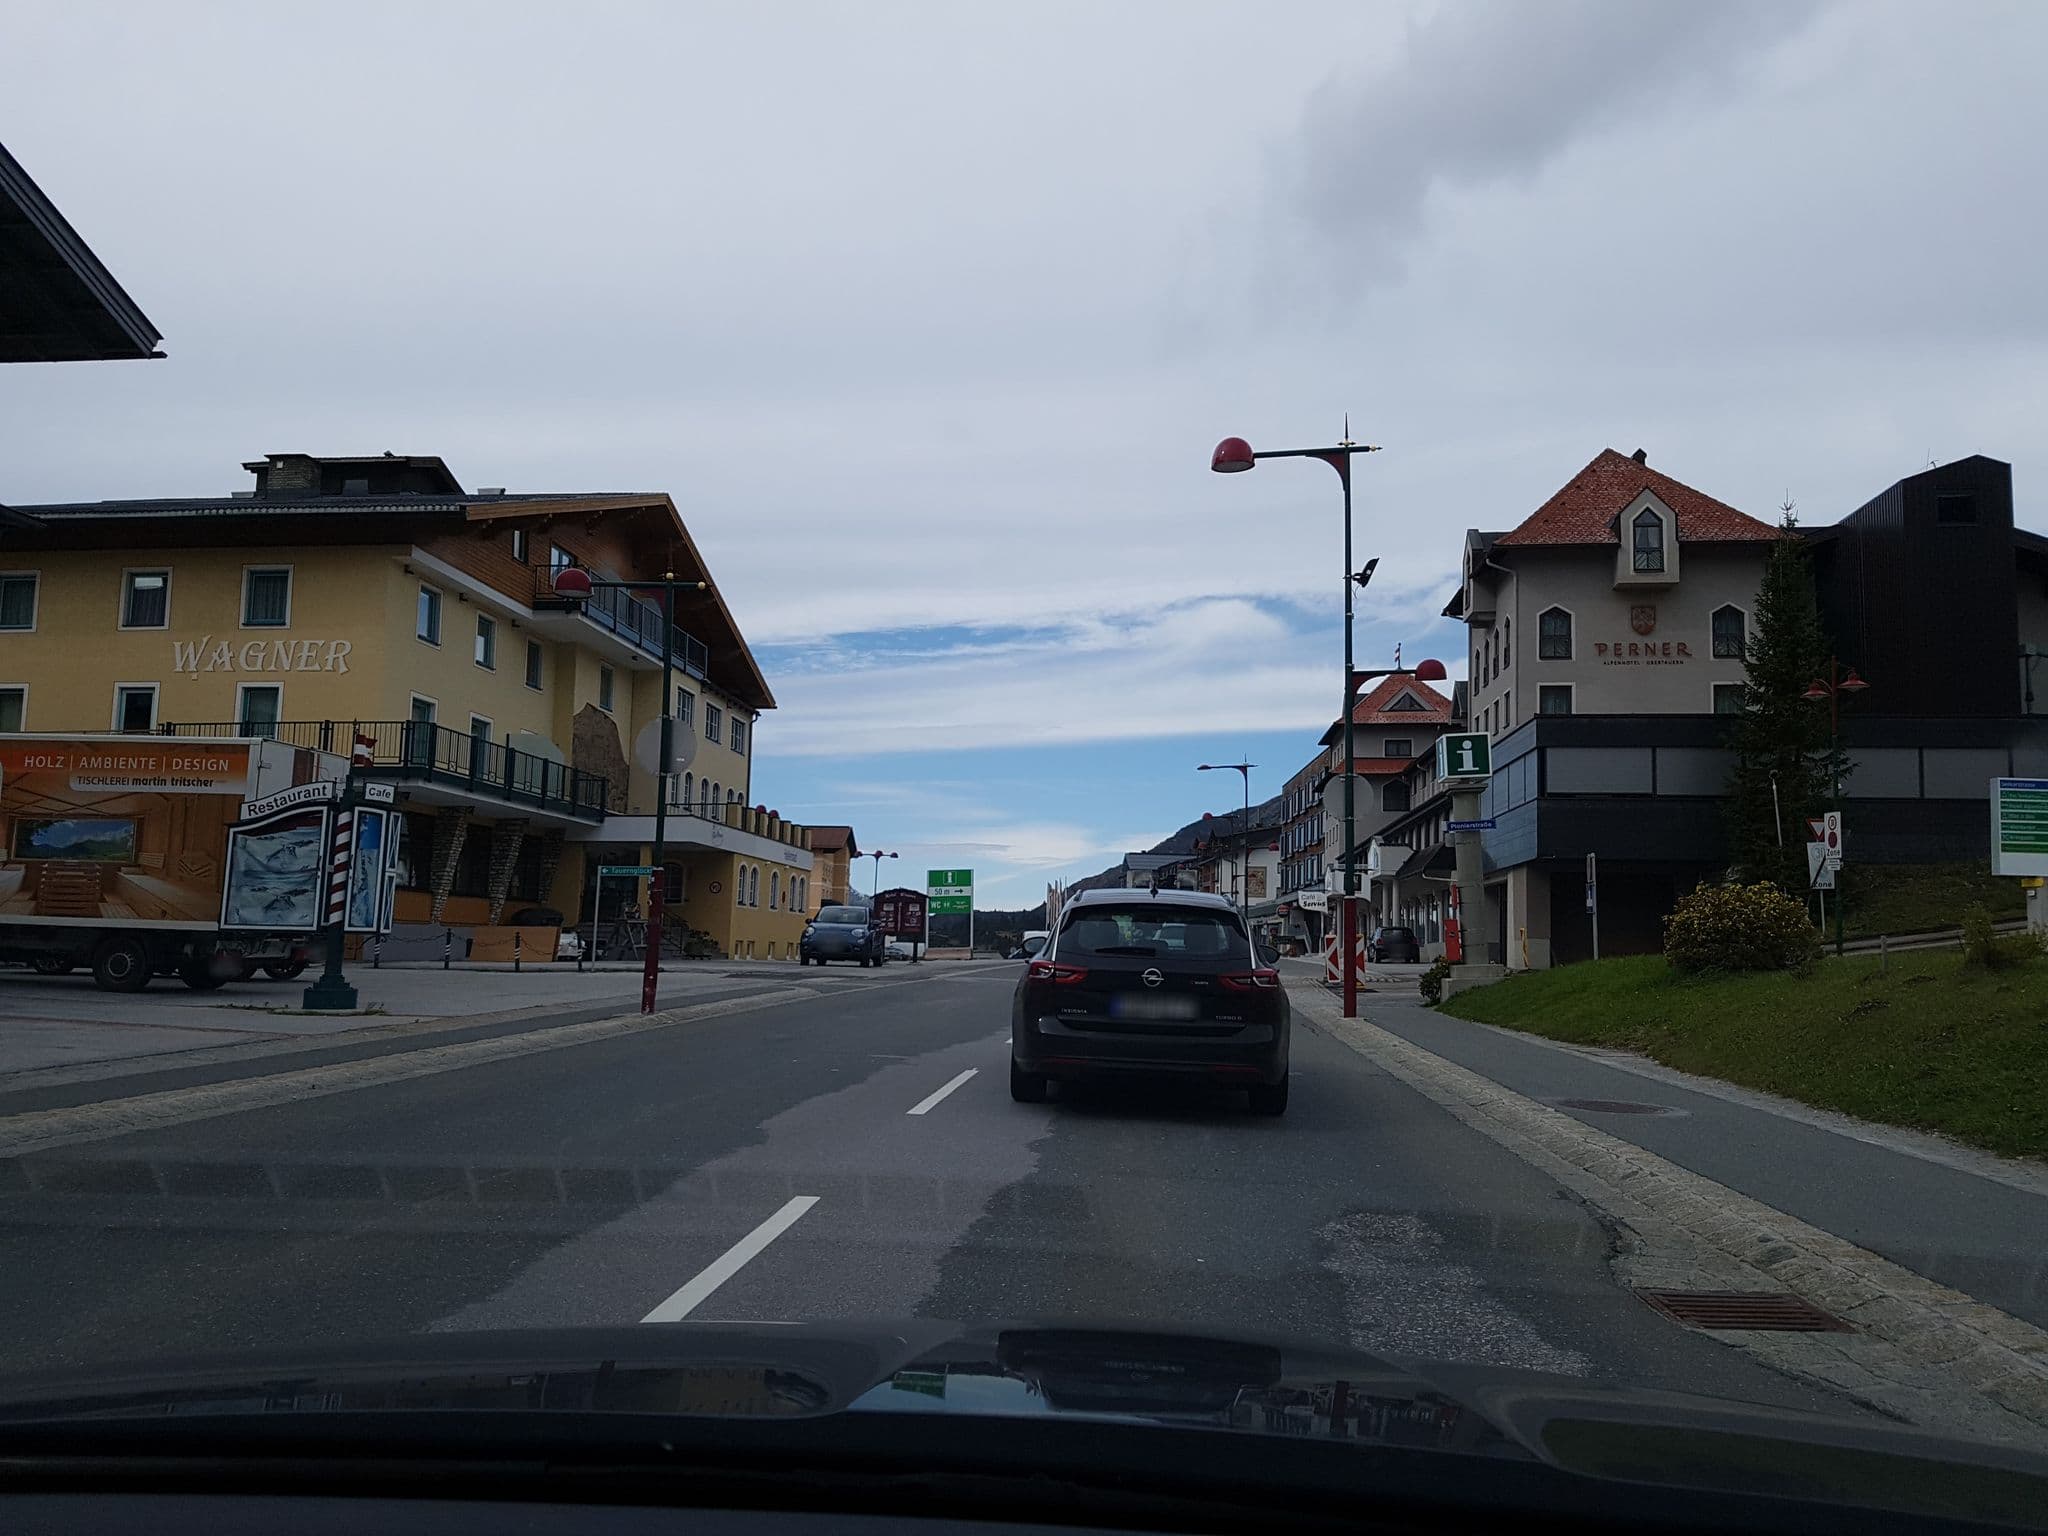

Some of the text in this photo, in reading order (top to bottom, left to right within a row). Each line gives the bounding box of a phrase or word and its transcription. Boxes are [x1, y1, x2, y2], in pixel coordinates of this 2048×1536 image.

[1594, 642, 1693, 657] PERNER
[173, 634, 353, 681] WAGNER
[24, 755, 229, 772] HOLZ AMBIENTE DESIGN
[77, 776, 214, 789] TISCHLEREI martin tritscher
[368, 787, 392, 799] Cafe
[247, 785, 328, 817] Restaurant
[935, 888, 943, 896] 50
[931, 901, 942, 909] WC
